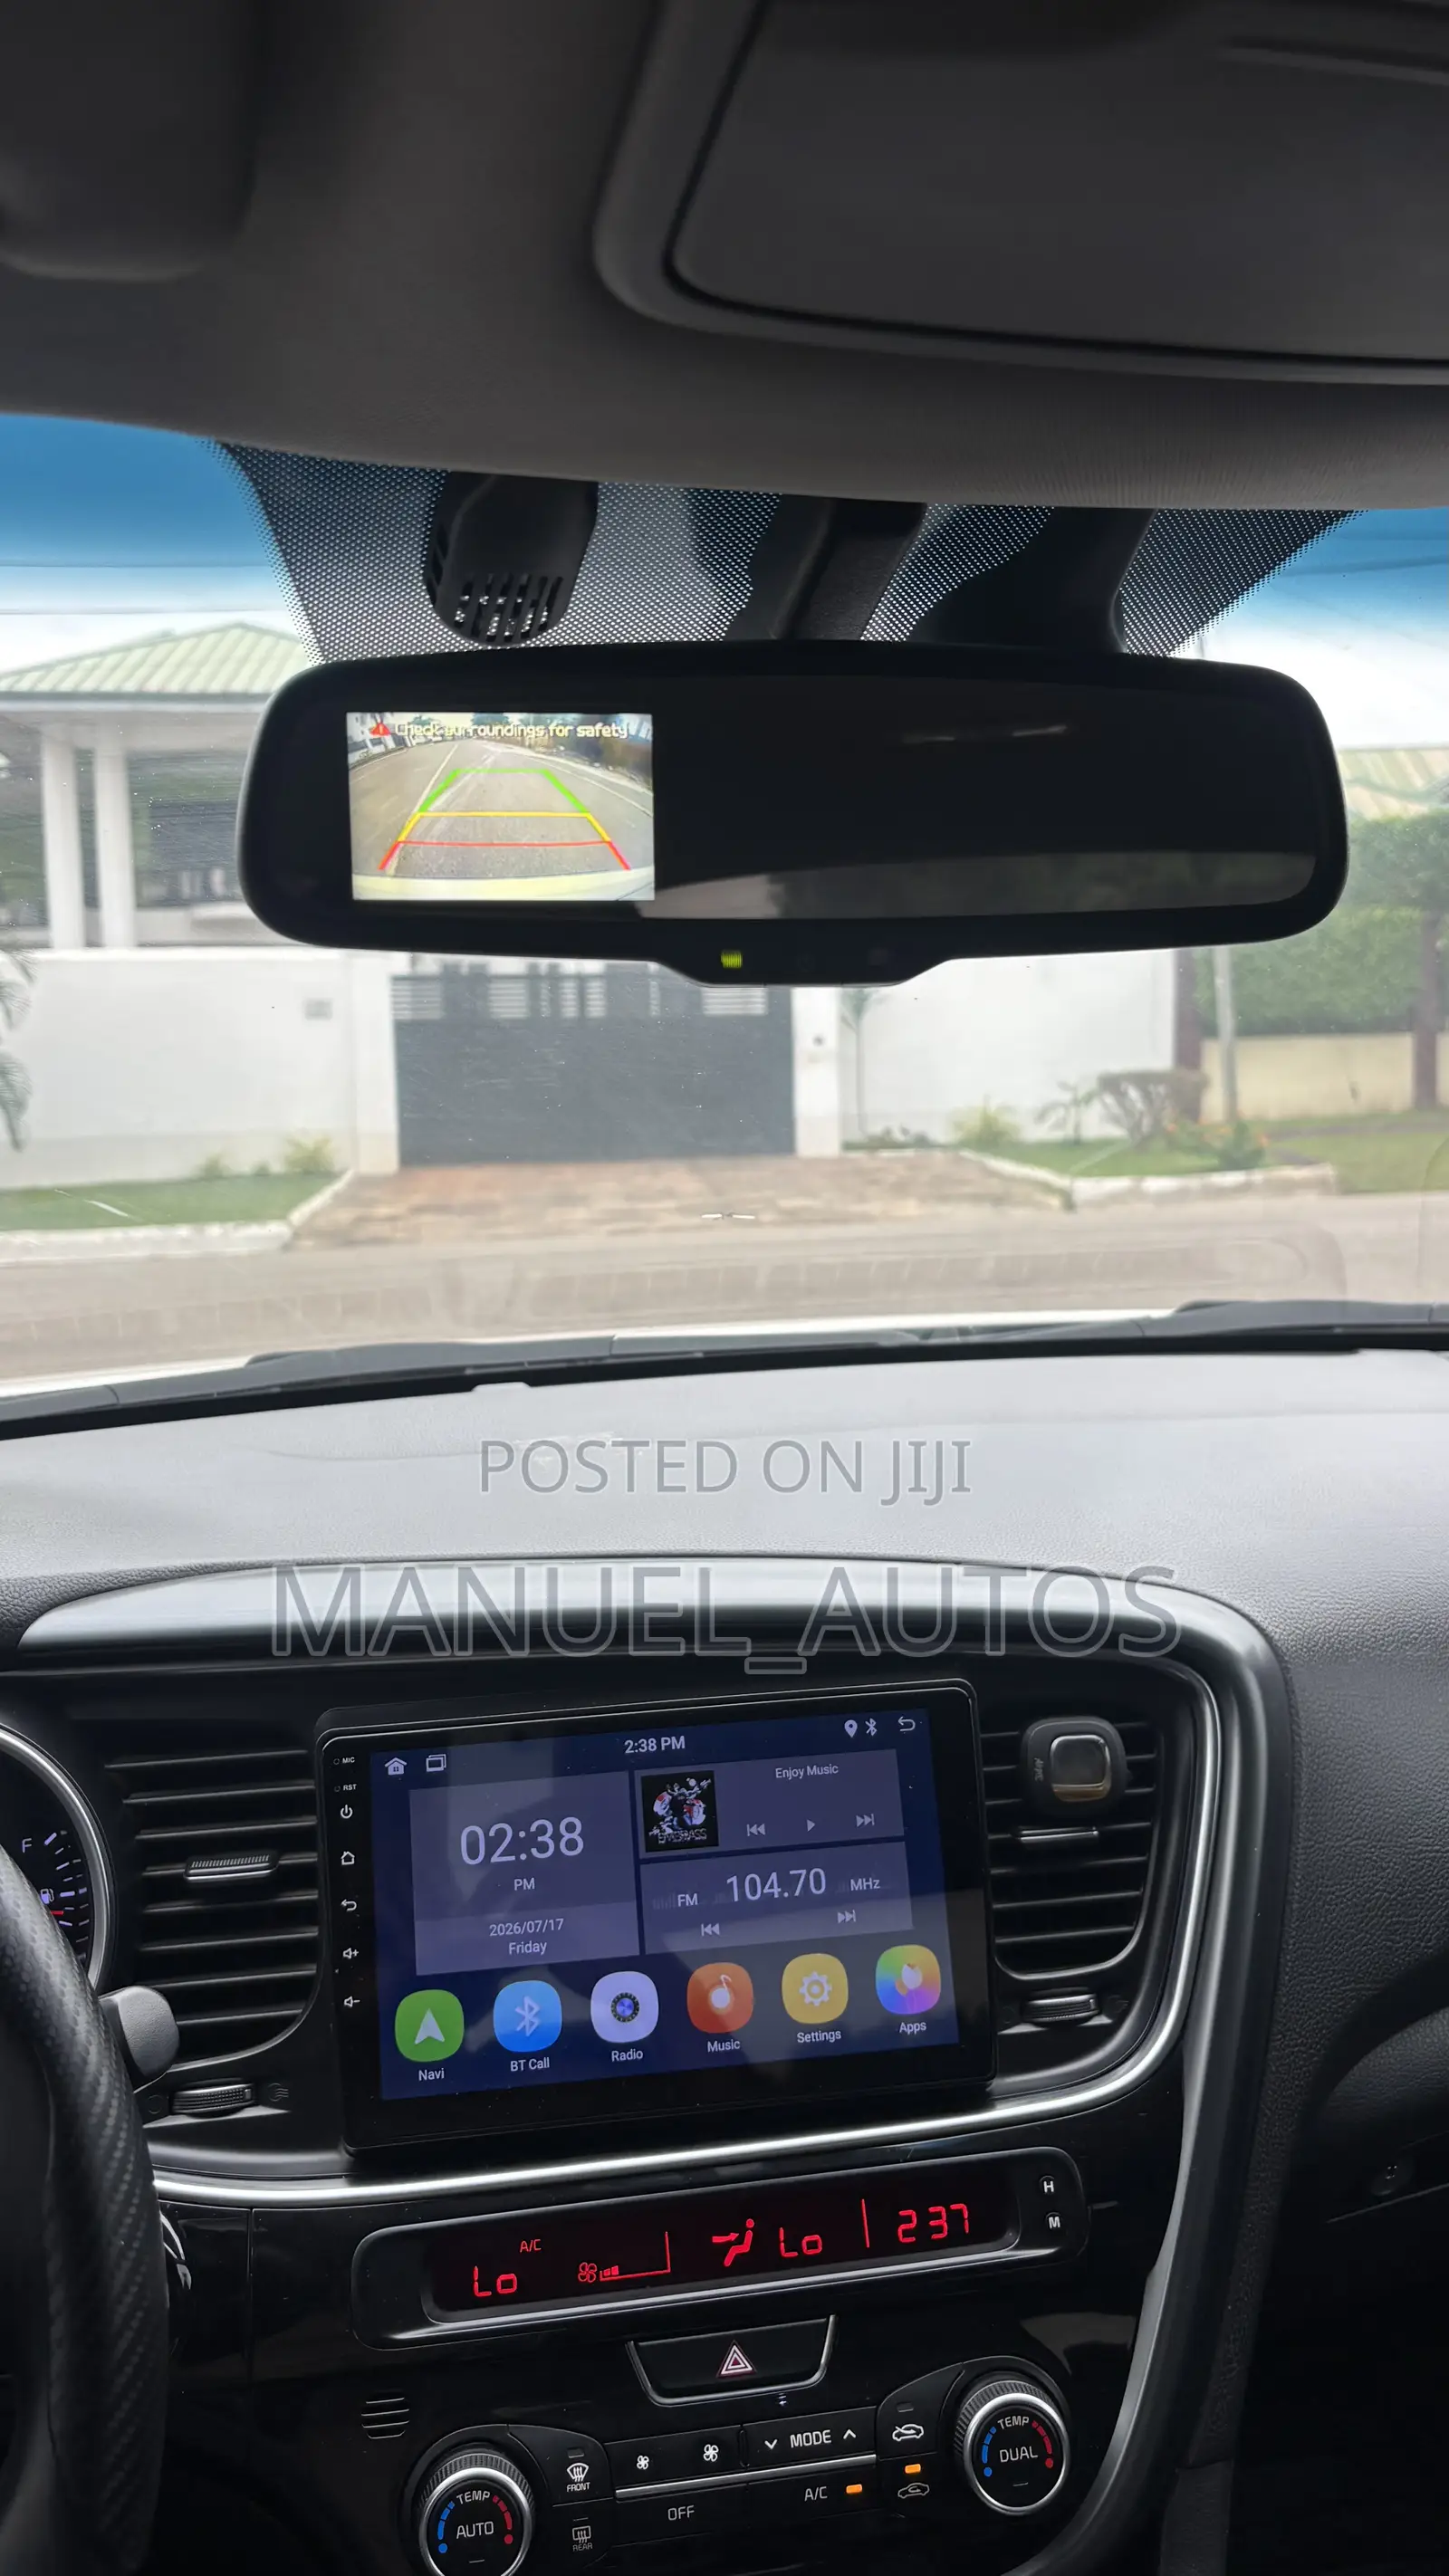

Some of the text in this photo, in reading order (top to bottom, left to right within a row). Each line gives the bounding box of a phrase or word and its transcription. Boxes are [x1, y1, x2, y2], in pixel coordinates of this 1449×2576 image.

[395, 722, 629, 740] Check surroundings for safety
[624, 1735, 686, 1755] 2:38 PM
[775, 1763, 839, 1779] Enjoy Music
[343, 1784, 357, 1792] RST
[22, 1838, 32, 1853] F
[460, 1816, 585, 1865] 02:38
[513, 1877, 536, 1891] PM
[677, 1867, 880, 1907] FM 104.70 MHz
[489, 1918, 564, 1937] 2026/07/17
[508, 1940, 547, 1956] Friday
[899, 2020, 926, 2035] Apps
[797, 2028, 841, 2044] Settings
[707, 2039, 741, 2053] Music
[611, 2048, 644, 2063] Radio
[510, 2056, 550, 2073] BT Call
[417, 2067, 446, 2082] Navi
[1043, 2180, 1054, 2193] H
[1049, 2216, 1060, 2228] M
[519, 2238, 542, 2253] A/C
[997, 2415, 1031, 2430] TEMP
[790, 2429, 832, 2448] MODE
[999, 2445, 1039, 2463] DUAL
[566, 2482, 591, 2493] FRONT
[804, 2485, 828, 2502] A/C
[456, 2490, 491, 2505] TEMP
[667, 2504, 696, 2522] OFF
[456, 2520, 494, 2540] AUTO
[572, 2542, 593, 2552] REAR
